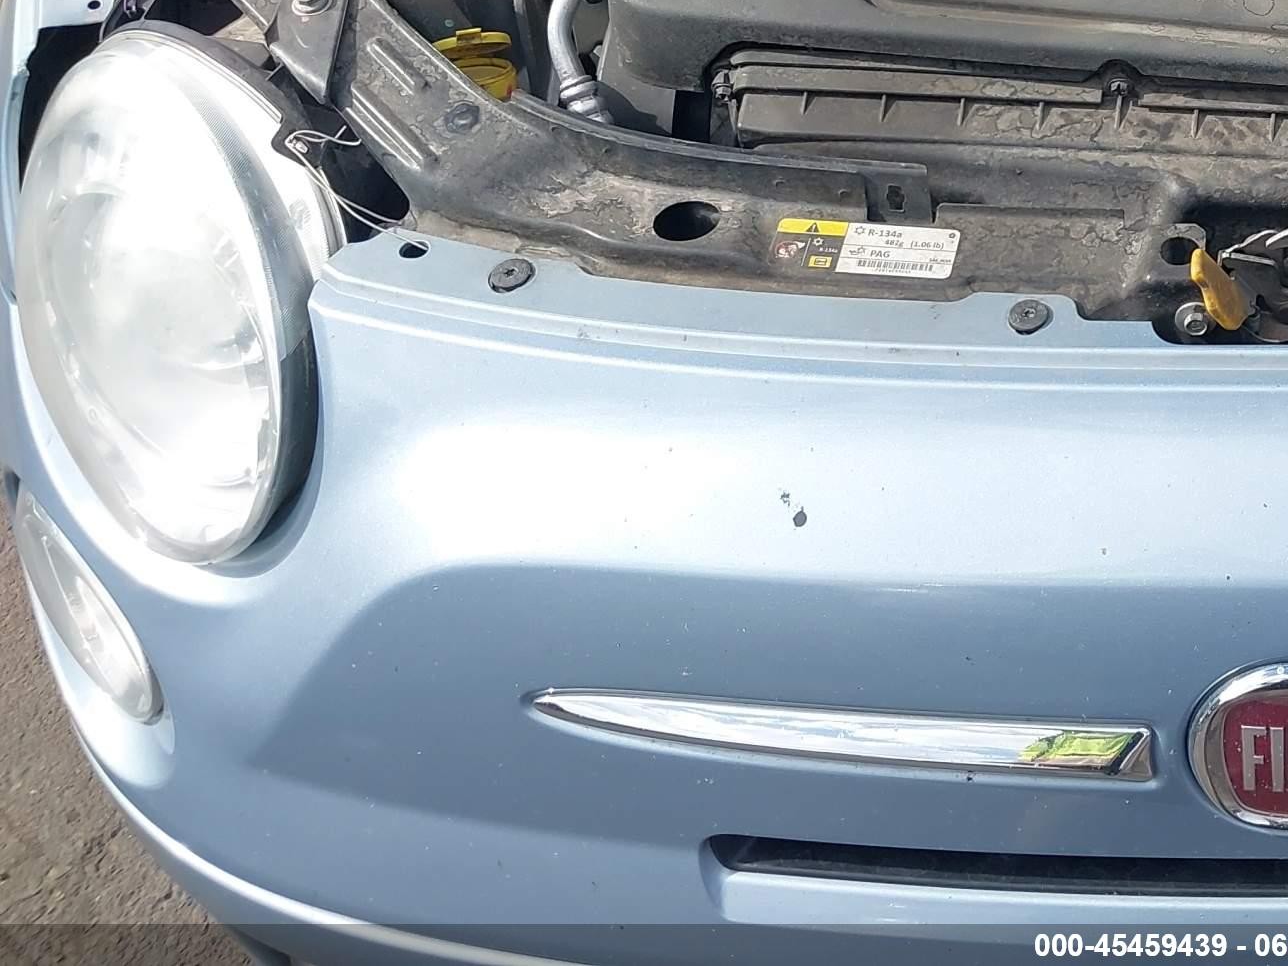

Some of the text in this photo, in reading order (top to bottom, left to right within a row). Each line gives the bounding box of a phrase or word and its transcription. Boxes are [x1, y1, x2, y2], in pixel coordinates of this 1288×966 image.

[868, 228, 903, 239] R-134a
[931, 242, 944, 250] lb)
[870, 250, 891, 258] PAG
